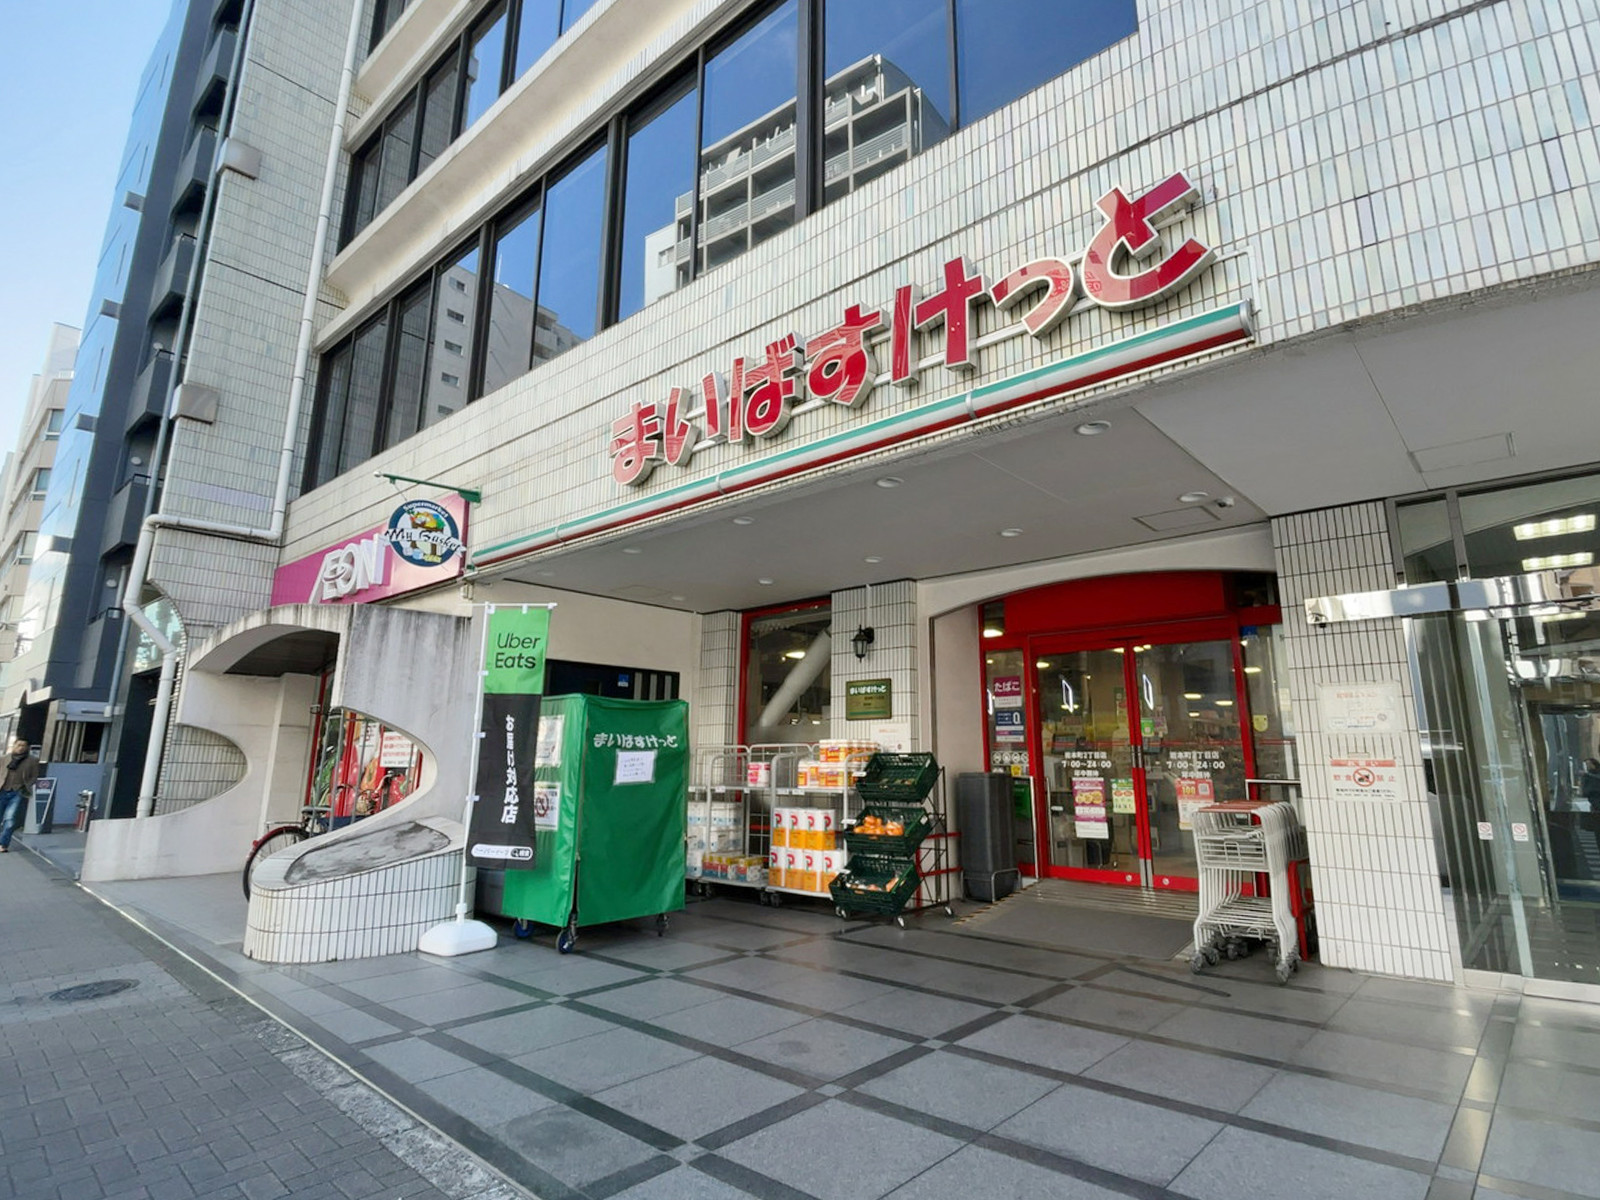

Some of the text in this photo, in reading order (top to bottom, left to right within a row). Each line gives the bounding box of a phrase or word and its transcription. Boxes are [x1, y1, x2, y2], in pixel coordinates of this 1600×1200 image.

[610, 171, 1215, 487] まいばすけっと
[402, 501, 450, 518] Supermarket
[497, 632, 541, 650] Uber
[495, 652, 537, 669] Eats
[994, 681, 1021, 693] たばこ
[500, 713, 519, 825] お届け対応店
